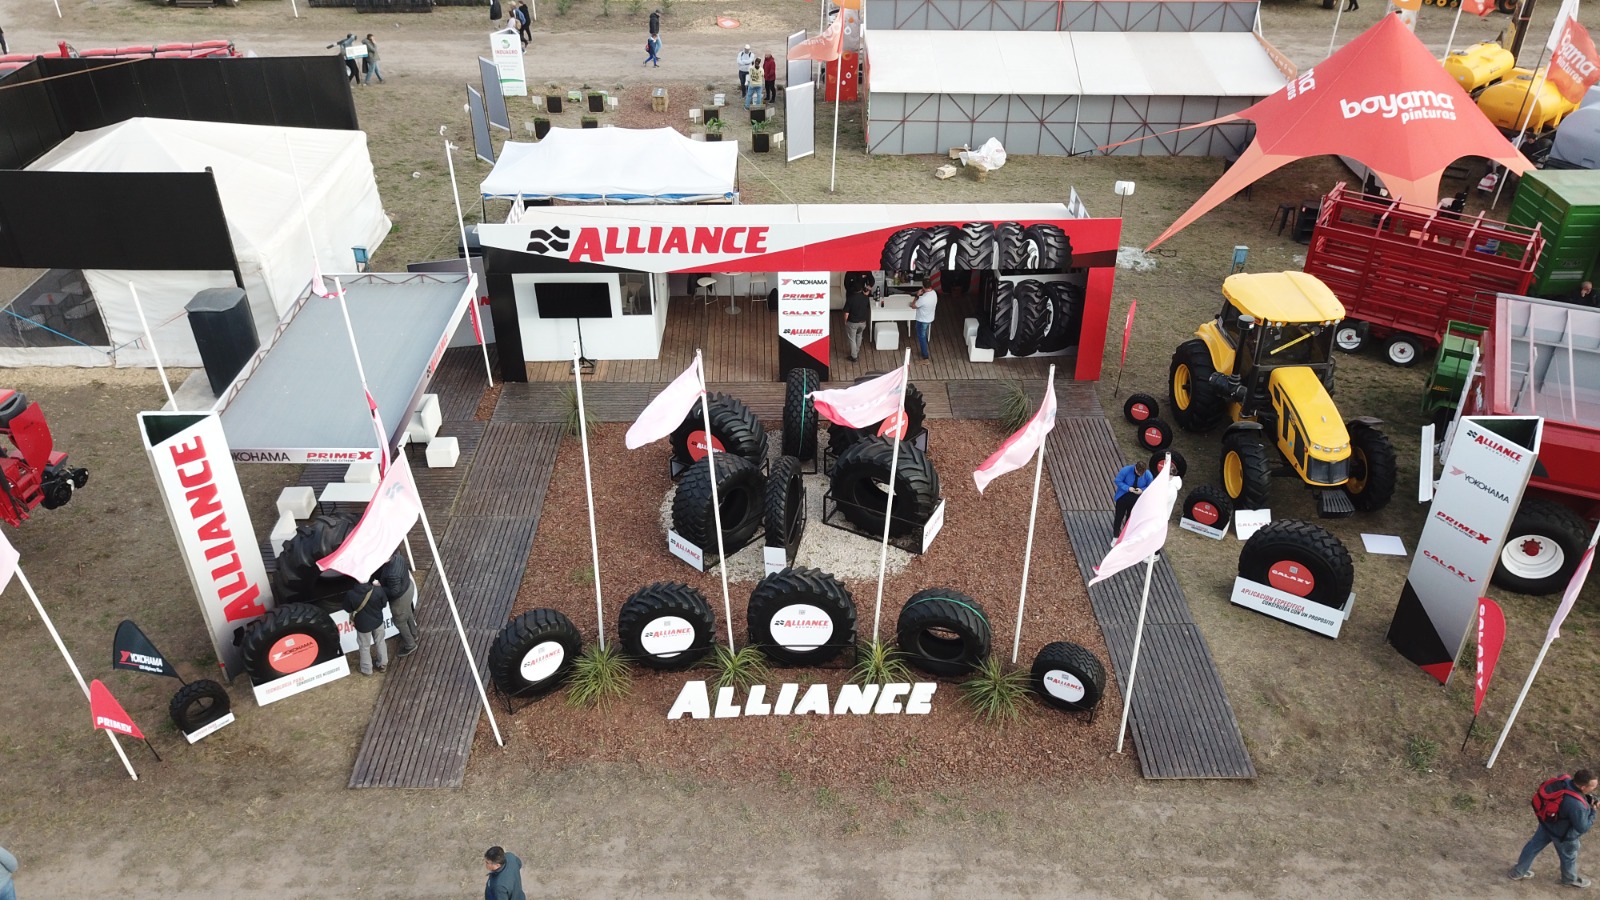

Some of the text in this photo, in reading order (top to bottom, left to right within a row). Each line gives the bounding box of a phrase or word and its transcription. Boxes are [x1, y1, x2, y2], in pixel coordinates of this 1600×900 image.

[1339, 90, 1455, 119] boyama
[1401, 108, 1457, 125] pinturas
[568, 226, 770, 263] ALLIANCE
[790, 328, 824, 336] ALLIANCE
[231, 451, 375, 462] KOHAMA PRIMEX
[1474, 434, 1524, 463] ALLIANCE
[1464, 473, 1510, 504] YOKOHAMA
[169, 435, 267, 624] ALLIANCE
[1436, 510, 1493, 544] PRIMEX
[675, 541, 701, 561] ALLIANCE
[1423, 549, 1477, 583] GALAXY
[1271, 569, 1312, 585] GALAXY
[653, 627, 691, 638] ALLIANCE
[784, 619, 829, 628] ALLIANCE
[1477, 603, 1486, 691] GALAXY
[130, 652, 163, 667] YOKOHAMA
[530, 648, 561, 667] ALLIANCE
[1053, 678, 1082, 691] ALLIANCE
[666, 679, 938, 720] ALLIANCE
[97, 716, 132, 734] PRIMEX
